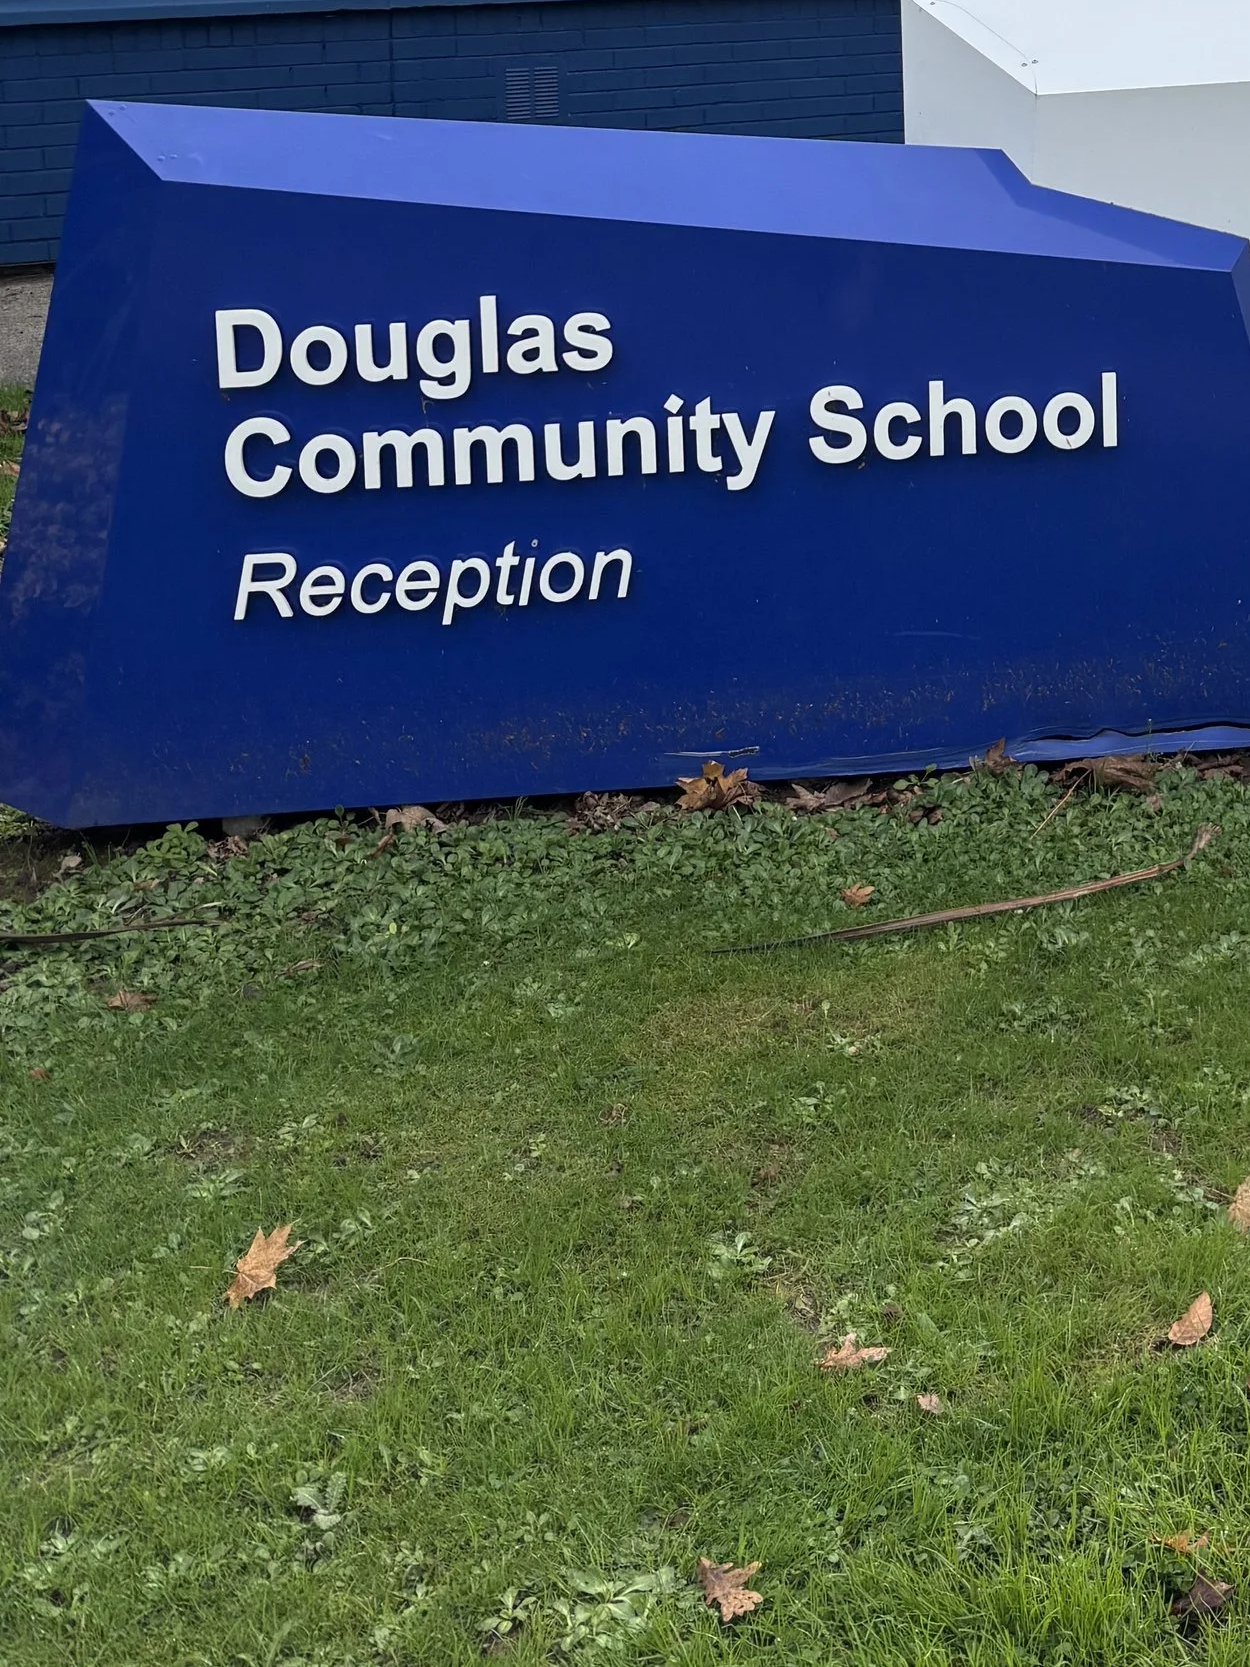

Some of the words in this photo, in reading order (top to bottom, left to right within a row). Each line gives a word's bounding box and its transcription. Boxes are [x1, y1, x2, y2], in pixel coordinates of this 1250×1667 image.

[215, 295, 614, 399] Douglas
[224, 393, 776, 498] Community
[809, 371, 1118, 464] School
[233, 539, 633, 625] Reception
